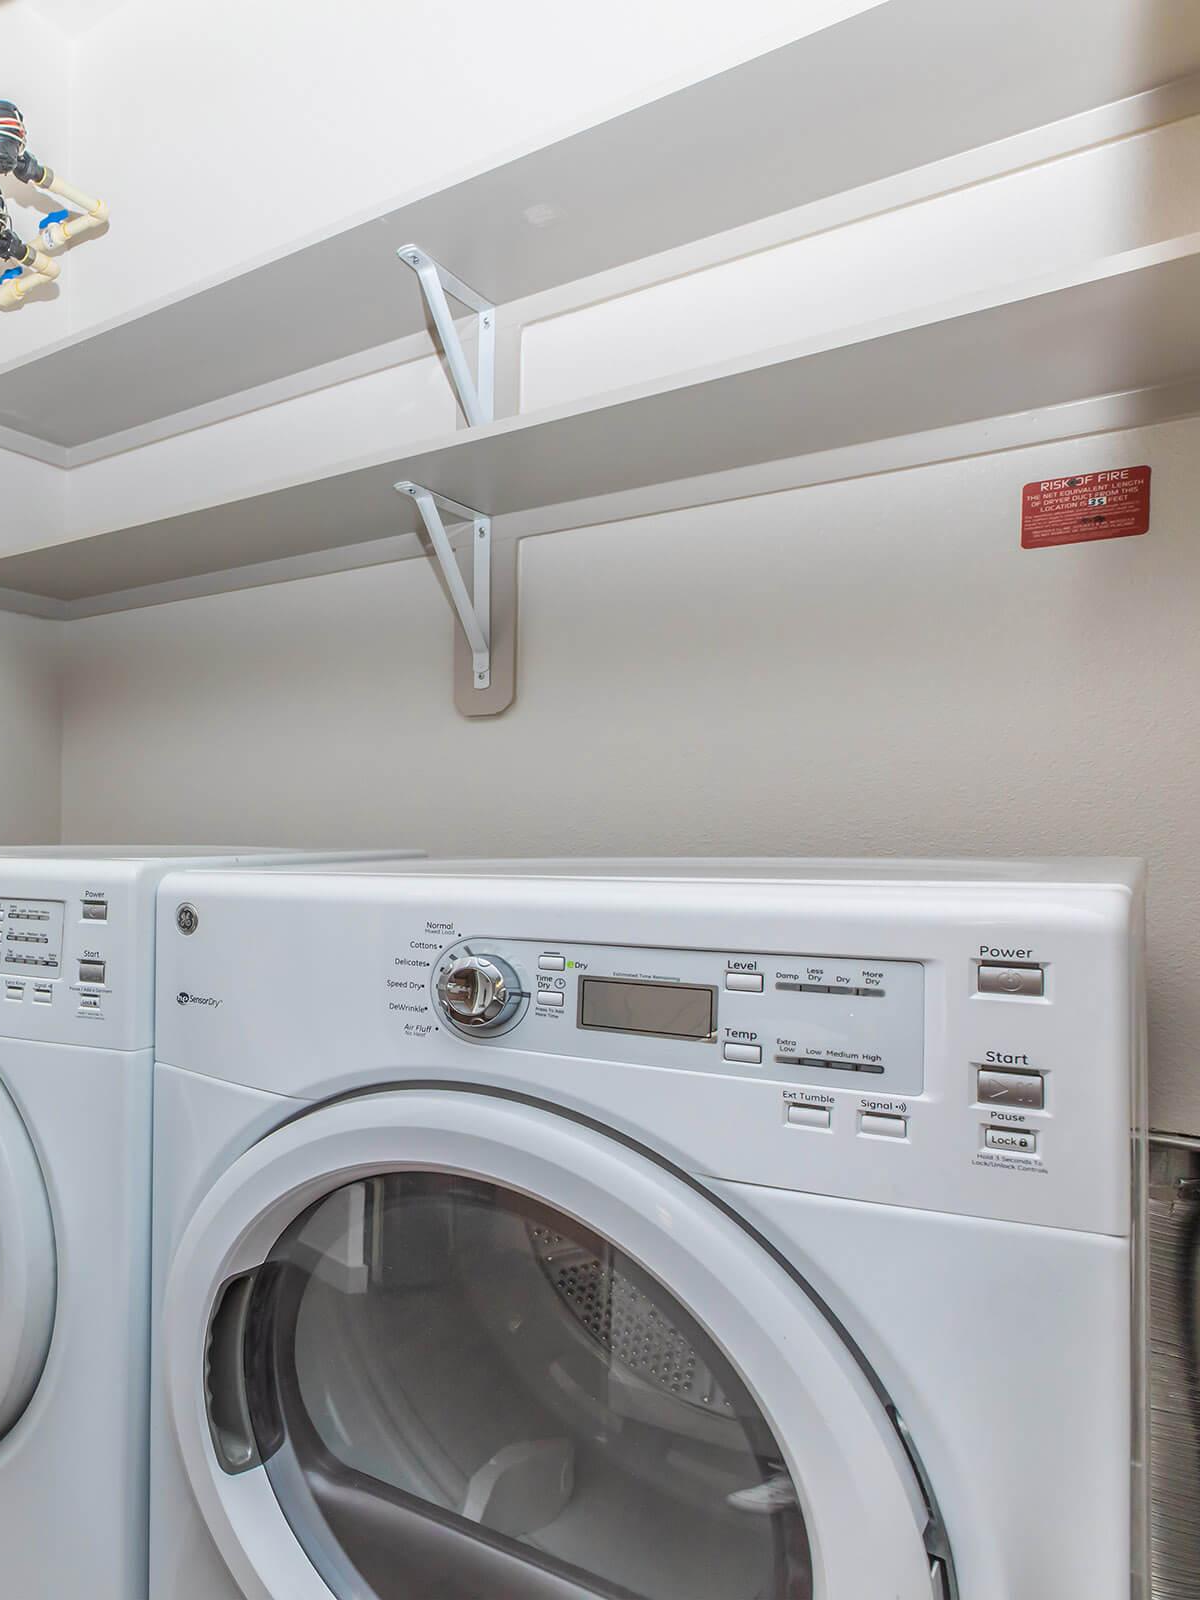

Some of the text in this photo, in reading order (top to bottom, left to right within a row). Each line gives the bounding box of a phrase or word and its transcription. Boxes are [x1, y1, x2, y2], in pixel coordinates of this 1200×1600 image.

[1041, 470, 1129, 492] RISK OF FIRE
[1027, 479, 1145, 502] THE NET EQUIVALENT LENGTH
[1031, 500, 1041, 508] OF
[1072, 492, 1093, 503] DUCT
[1094, 488, 1120, 499] FROM
[1122, 485, 1140, 495] THIS
[1041, 501, 1078, 513] LOCATION
[1079, 500, 1088, 509] IS
[1107, 493, 1129, 503] FEET
[85, 890, 105, 898] Power
[426, 921, 454, 930] Normal
[409, 940, 438, 950] Cottons
[83, 949, 100, 958] Start
[979, 945, 1033, 960] Power
[394, 957, 427, 968] Delicates
[574, 961, 589, 971] Dry
[727, 960, 758, 971] Level
[806, 967, 824, 975] Less
[862, 970, 884, 979] More
[535, 974, 553, 983] Time
[775, 972, 800, 981] Damp
[808, 973, 823, 982] Dry
[836, 975, 851, 984] Dry
[865, 977, 881, 986] Dry
[386, 979, 422, 991] Speed Dry
[537, 981, 551, 990] Dry
[388, 1002, 426, 1014] DeWrinkle
[403, 1023, 433, 1033] Air Fluff
[725, 1028, 758, 1042] Temp
[776, 1038, 797, 1047] Extra
[779, 1045, 796, 1053] Low
[805, 1047, 882, 1064] Low Medium High
[985, 1050, 1029, 1066] Start
[782, 1090, 836, 1104] Ext Tumble
[860, 1099, 894, 1113] Signal
[990, 1111, 1026, 1123] Pause
[991, 1135, 1018, 1147] Lock
